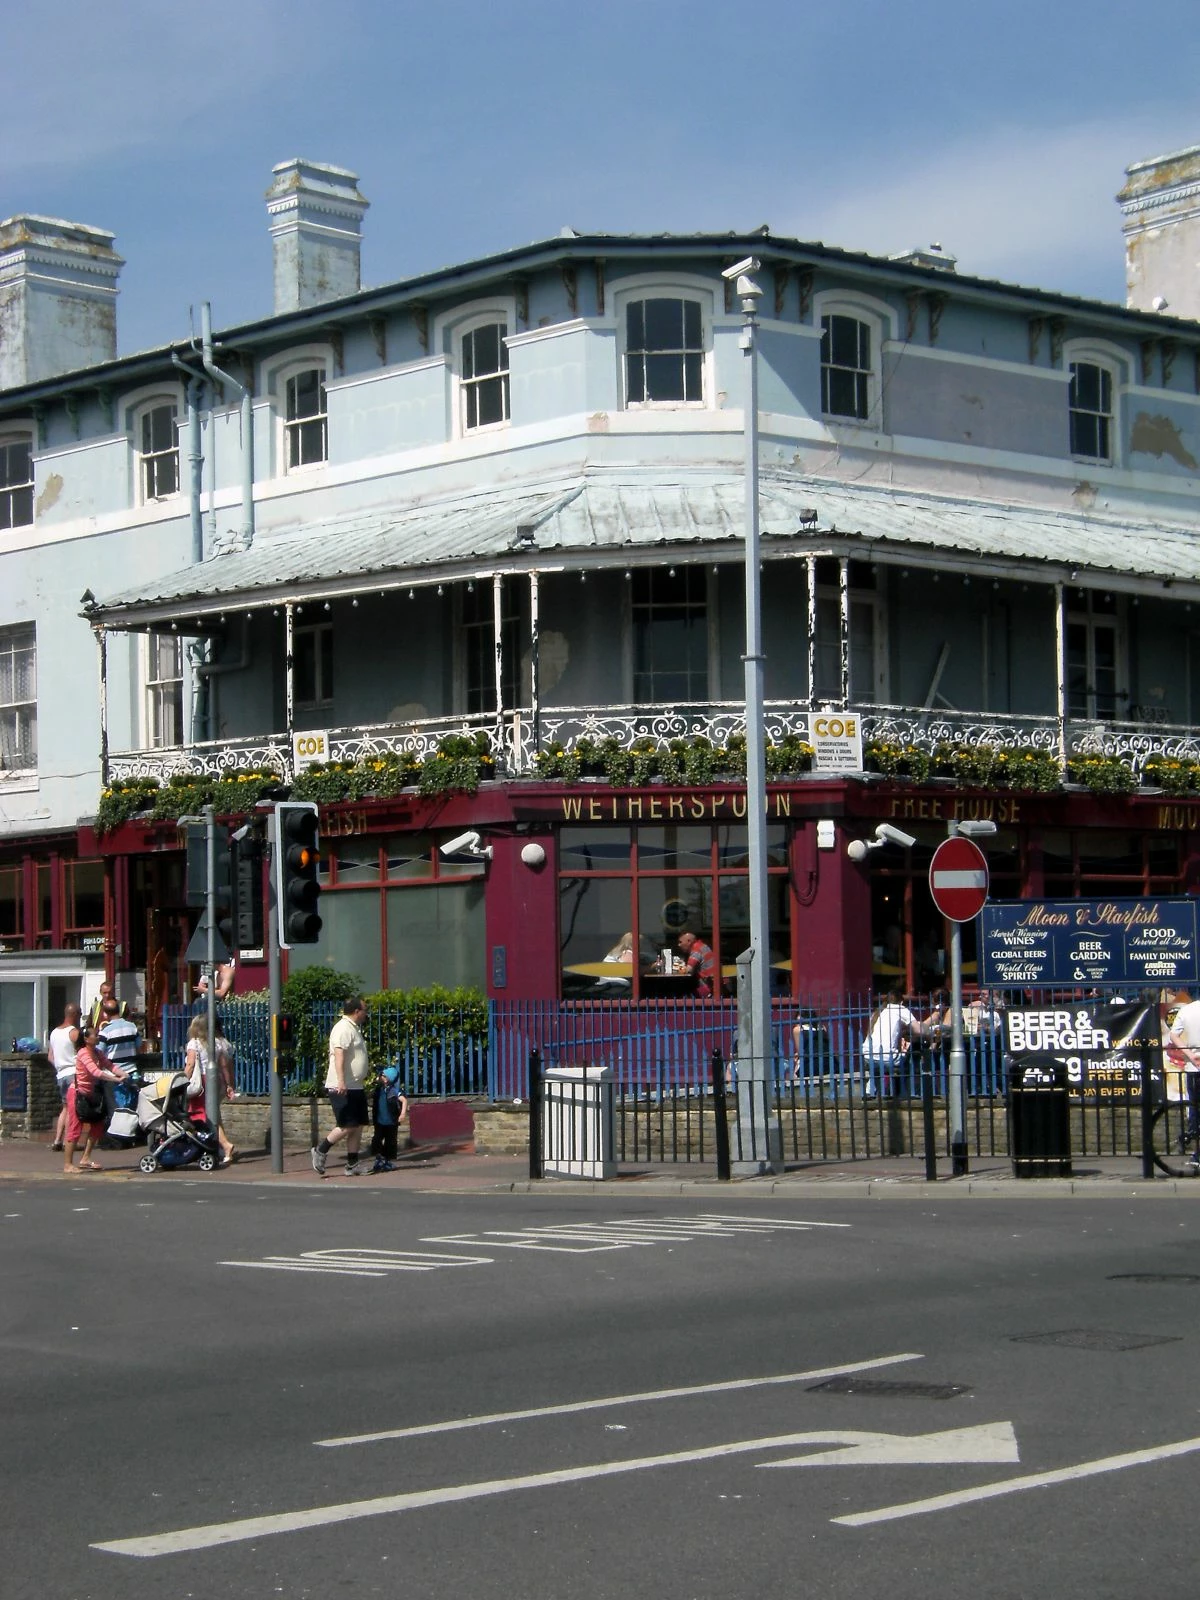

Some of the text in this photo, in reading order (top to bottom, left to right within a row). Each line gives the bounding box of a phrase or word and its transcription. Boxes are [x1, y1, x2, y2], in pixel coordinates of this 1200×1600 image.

[814, 718, 856, 738] COE
[297, 736, 324, 756] COE
[890, 797, 1021, 823] FREE HOUSE
[1016, 902, 1159, 932] Moon & Starfish
[988, 928, 1048, 940] Award Winning
[1143, 928, 1176, 938] FOOD
[1003, 936, 1035, 945] WINES
[1079, 941, 1102, 951] BEER
[1128, 936, 1191, 949] Served all Day
[991, 950, 1047, 959] GLOBAL BEERS
[1070, 951, 1111, 961] GARDEN
[1129, 952, 1191, 961] FAMILY DINING
[995, 962, 1044, 972] World Class
[1145, 968, 1176, 977] COFFEE
[1002, 971, 1038, 981] SPIRITS
[1008, 1010, 1093, 1032] BEER &
[1010, 1029, 1110, 1051] BURGER
[1111, 1038, 1159, 1048] WTH CPS
[1087, 1057, 1141, 1070] includes
[1088, 1069, 1124, 1081] FREE
[1101, 1087, 1127, 1097] EVER
[1131, 1086, 1143, 1097] DA
